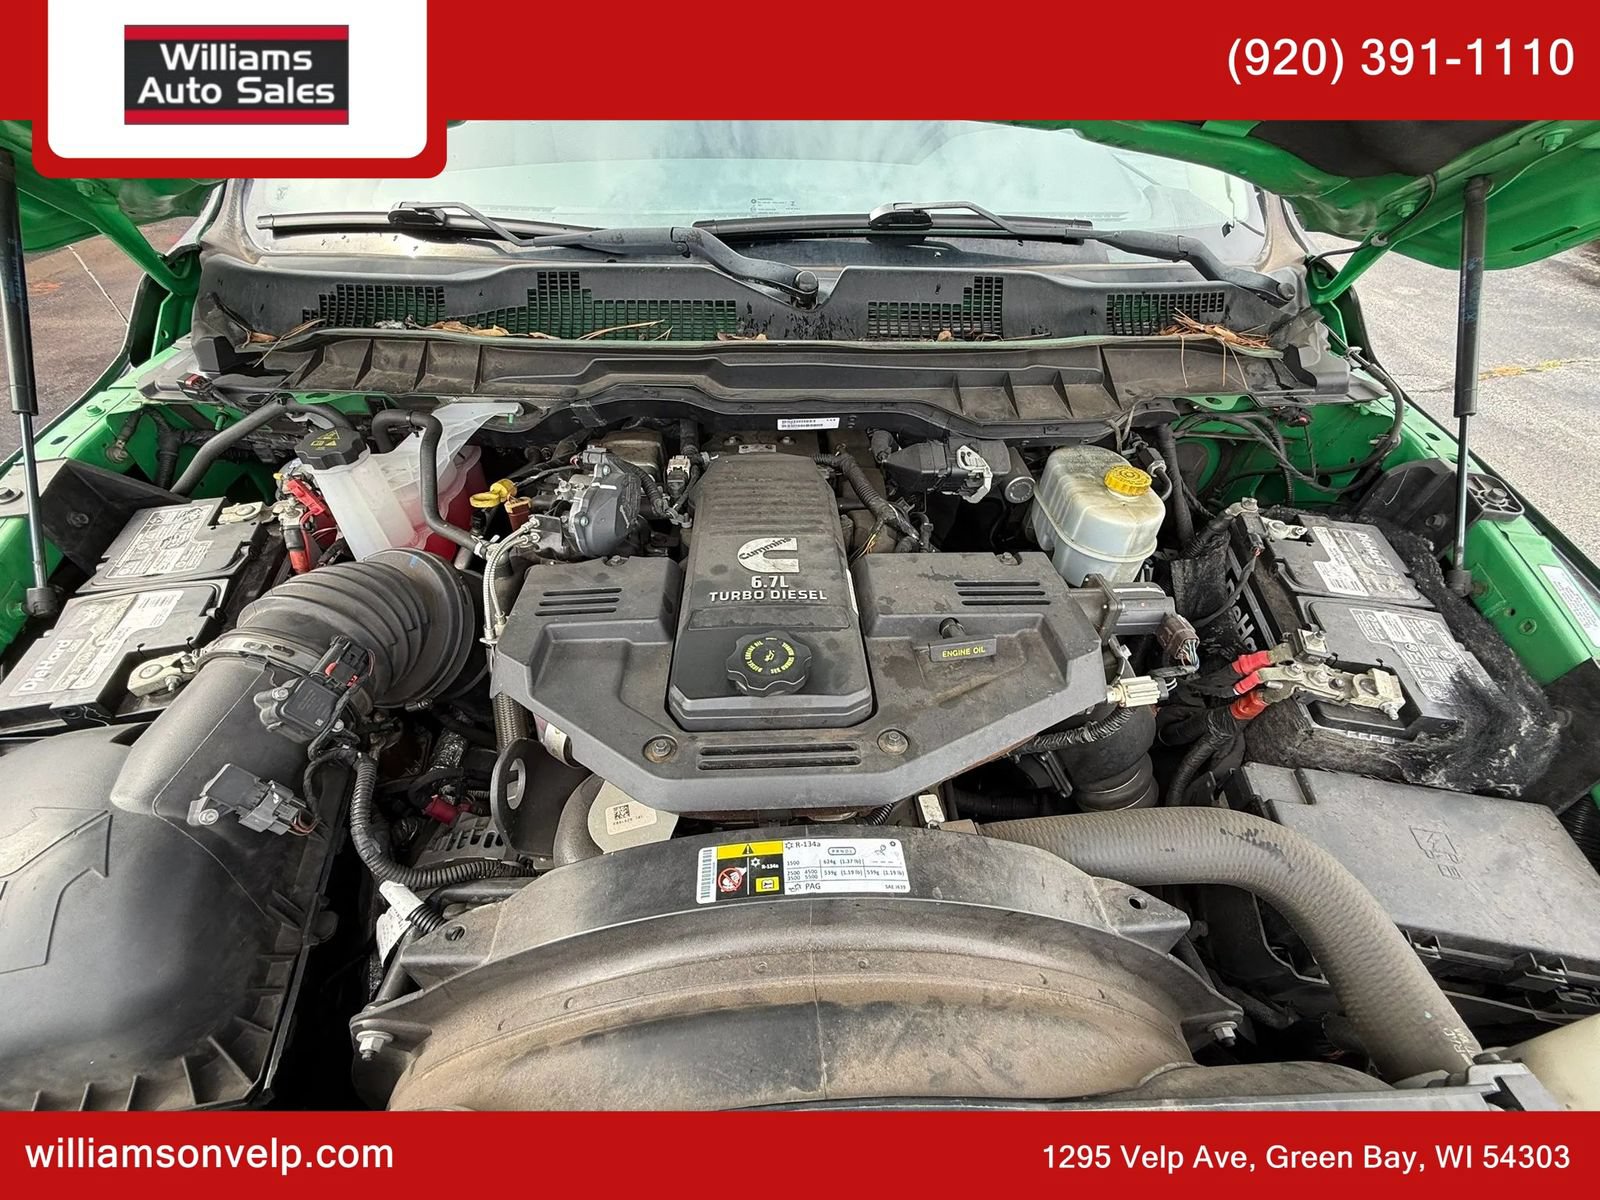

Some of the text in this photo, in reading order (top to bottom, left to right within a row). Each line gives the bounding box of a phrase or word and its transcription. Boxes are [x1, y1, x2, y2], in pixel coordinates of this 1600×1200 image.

[738, 536, 792, 561] Cummins
[751, 575, 789, 589] 6.7L
[709, 589, 828, 602] TURBO DIESEL
[942, 645, 986, 658] ENGINE OIL
[17, 639, 75, 692] DieHard
[805, 882, 821, 891] PAG
